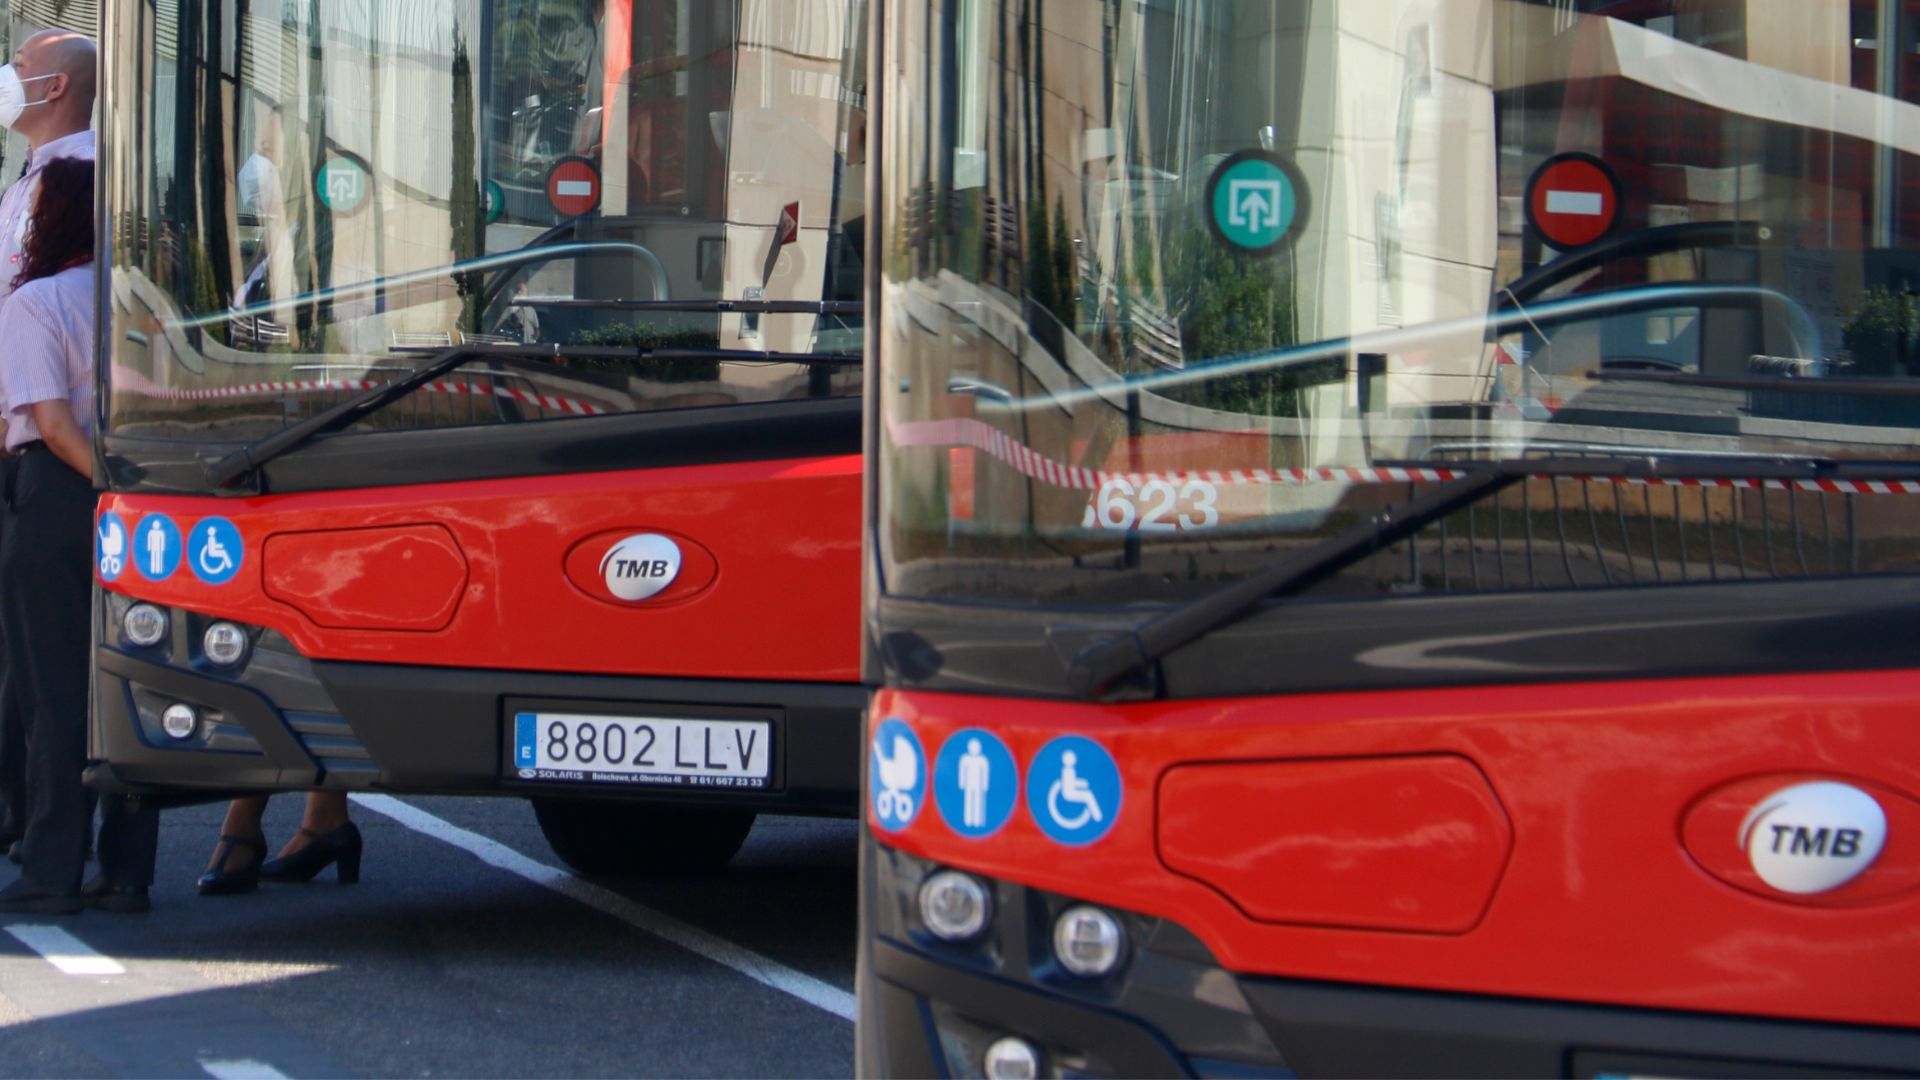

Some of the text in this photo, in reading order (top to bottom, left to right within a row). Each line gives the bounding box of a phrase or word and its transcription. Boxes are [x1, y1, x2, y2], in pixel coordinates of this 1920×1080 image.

[616, 559, 668, 578] TMB
[521, 746, 531, 759] E
[546, 720, 757, 771] 8802 LLV
[538, 770, 584, 780] SOLARIS
[736, 777, 748, 787] 23
[750, 778, 763, 787] 33
[1770, 824, 1864, 858] TMB
